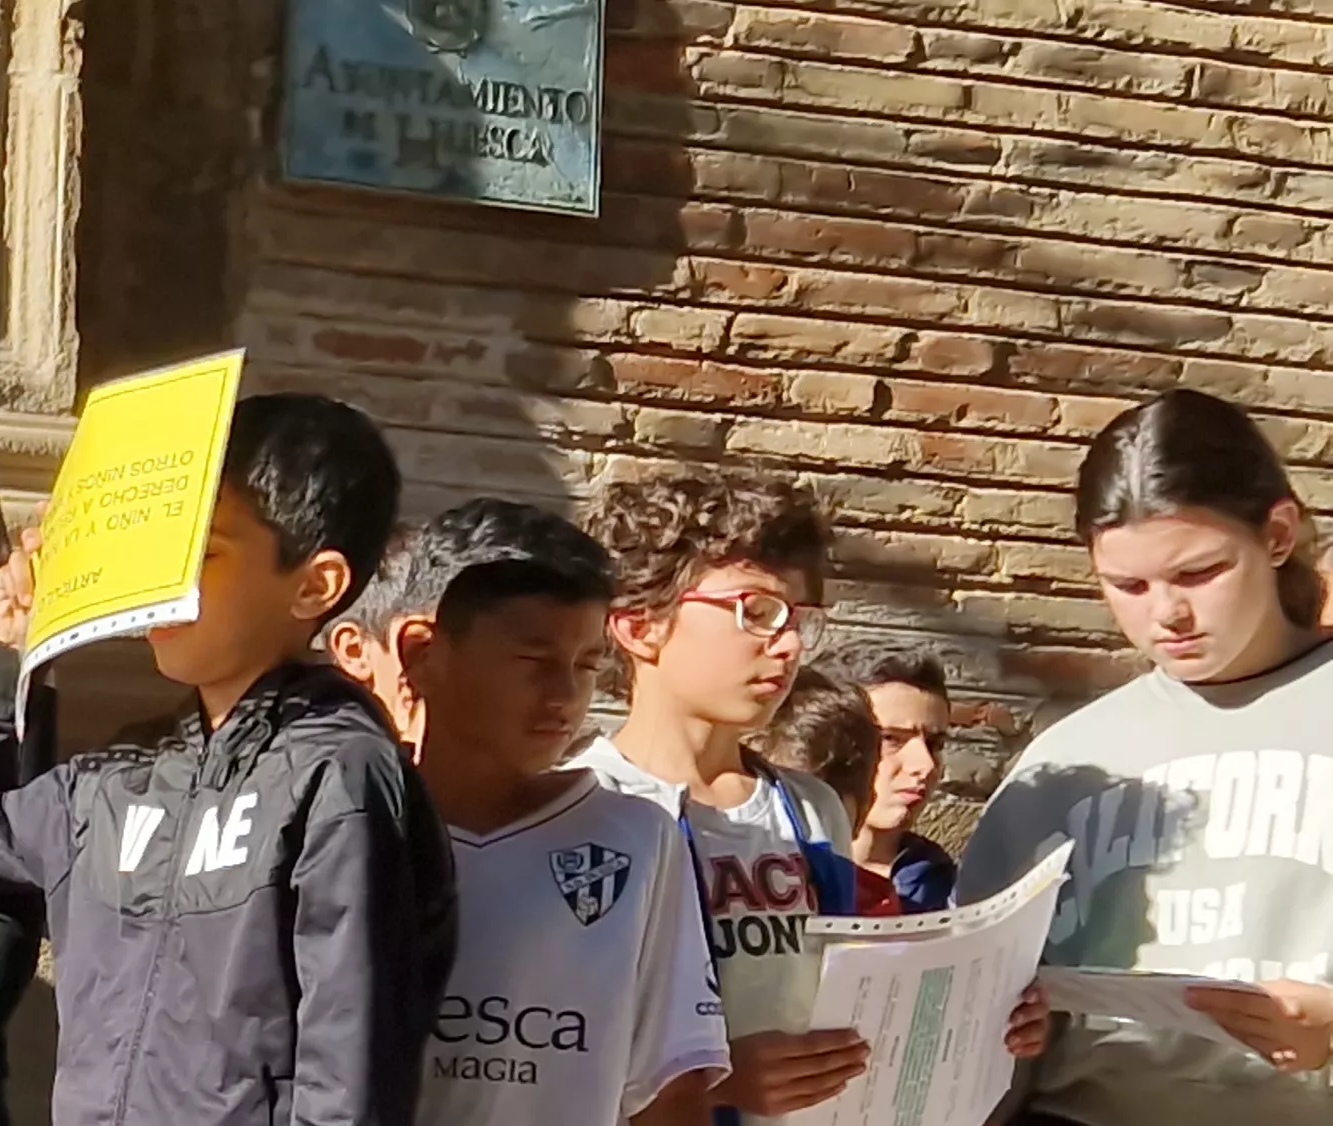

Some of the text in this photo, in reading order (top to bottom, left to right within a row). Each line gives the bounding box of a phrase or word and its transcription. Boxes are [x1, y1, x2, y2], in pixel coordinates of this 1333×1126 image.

[394, 111, 555, 168] HUESCA
[129, 450, 194, 477] OTROS
[82, 498, 93, 514] A
[99, 474, 189, 509] DERECHO
[163, 500, 184, 518] EL
[707, 853, 818, 915] AC
[714, 914, 811, 959] JON
[1156, 882, 1247, 946] USA
[431, 994, 589, 1053] esca
